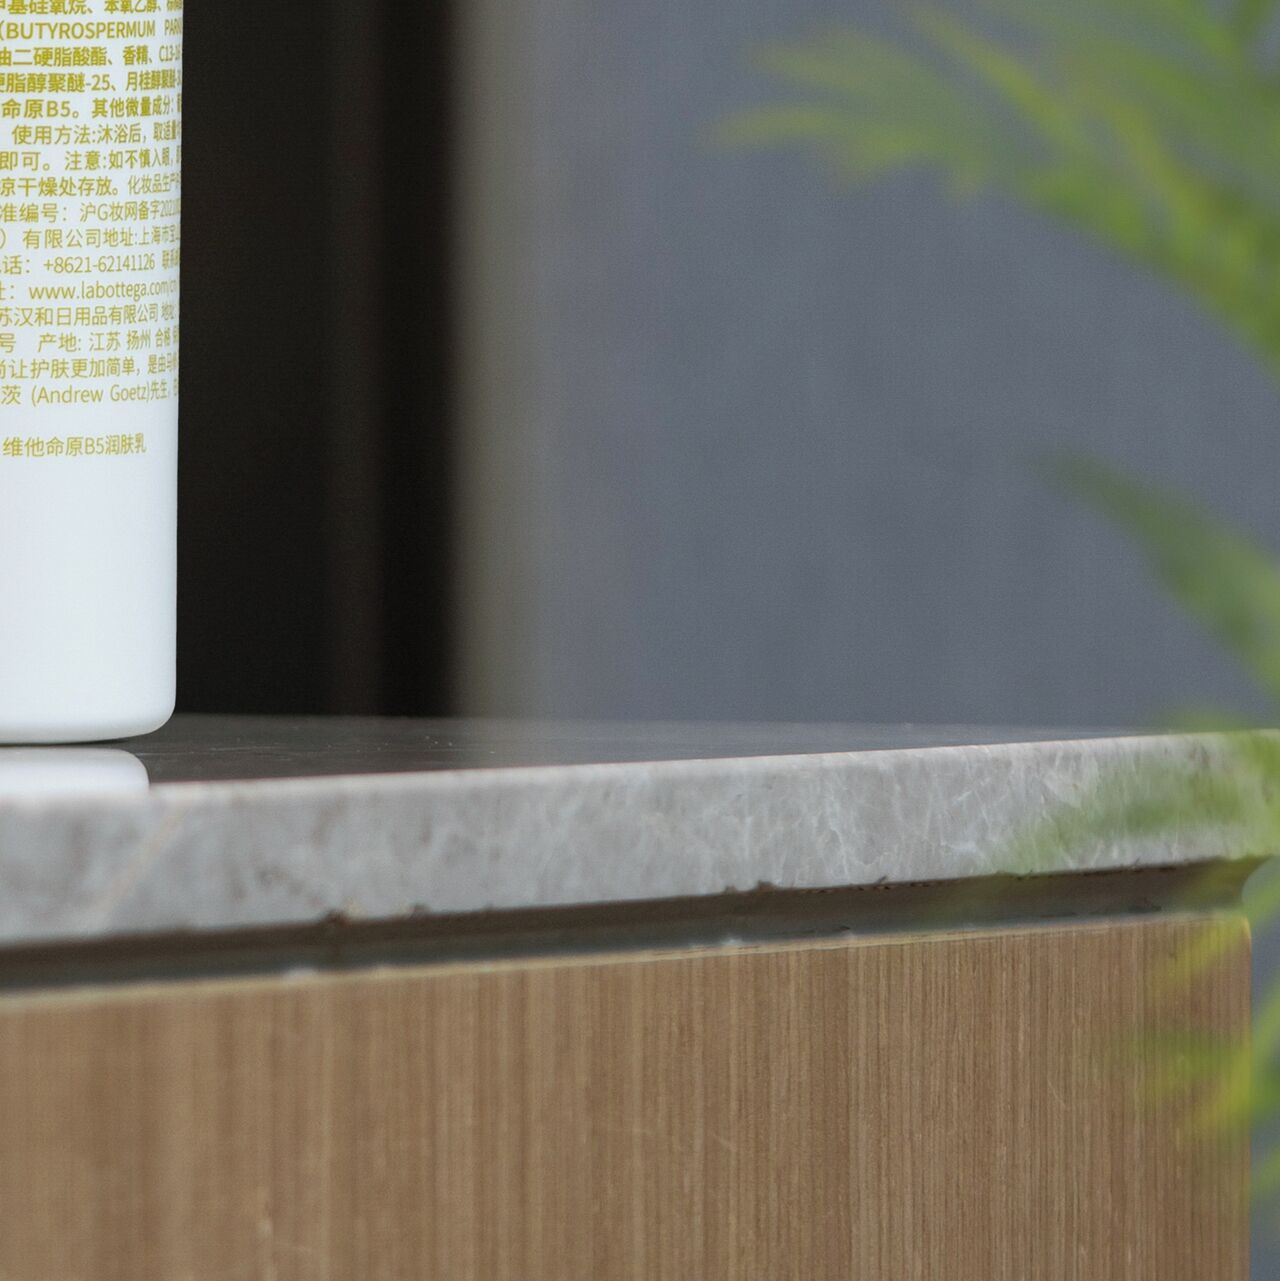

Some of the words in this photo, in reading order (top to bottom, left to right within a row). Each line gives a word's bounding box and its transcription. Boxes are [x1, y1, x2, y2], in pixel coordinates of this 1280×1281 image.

[43, 252, 156, 275] +8621-62141126
[89, 330, 121, 353] 江苏
[126, 328, 151, 351] 扬州
[31, 384, 104, 408] (Andrew
